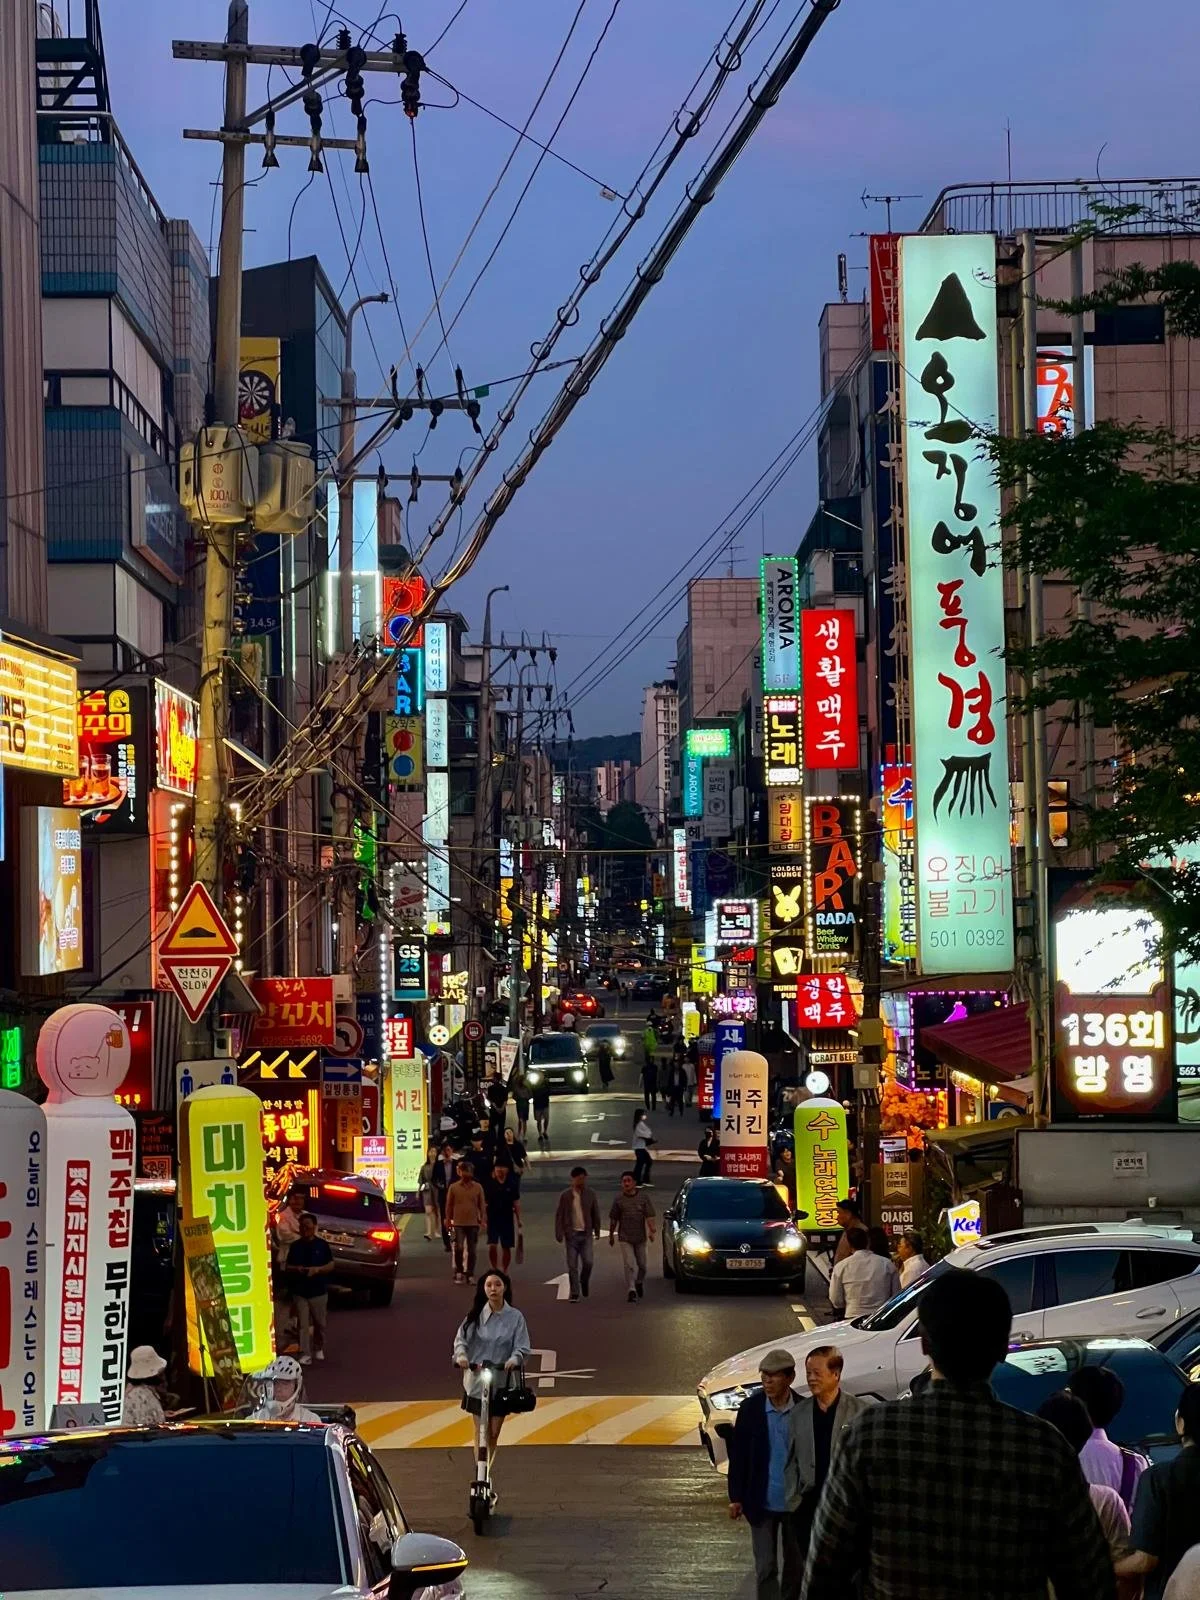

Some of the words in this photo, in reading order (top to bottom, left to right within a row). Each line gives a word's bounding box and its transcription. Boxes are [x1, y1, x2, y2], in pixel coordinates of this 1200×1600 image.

[777, 567, 795, 650] AROMA
[395, 654, 411, 715] BAR
[815, 617, 846, 761] 생활맥주
[771, 715, 796, 764] 노래
[688, 774, 697, 807] AROMA
[813, 804, 857, 911] BAR
[926, 855, 1006, 884] 오징어
[928, 889, 1006, 919] 불고기
[720, 914, 751, 928] 노래
[816, 912, 856, 925] RADA
[816, 935, 849, 944] Whiskey
[930, 930, 958, 947] 501
[965, 929, 1006, 946] 0392
[398, 944, 421, 959] GS
[177, 967, 212, 979] 천천히
[399, 959, 421, 973] 25
[182, 980, 209, 991] SLOW
[803, 1002, 846, 1025] 맥주
[1061, 1009, 1164, 1049] 136회
[814, 1053, 838, 1063] CRAFT
[1179, 1066, 1196, 1076] 562
[1075, 1054, 1154, 1094] 방영
[395, 1089, 422, 1112] 치킨
[725, 1088, 763, 1109] 맥주
[725, 1115, 762, 1135] 치킨
[806, 1110, 840, 1141] 수
[396, 1128, 422, 1150] 호프
[25, 1130, 41, 1208] 오늘의
[813, 1144, 840, 1227] 노래연습장
[23, 1222, 39, 1361] 스트레스는
[22, 1371, 37, 1427] 오늘
